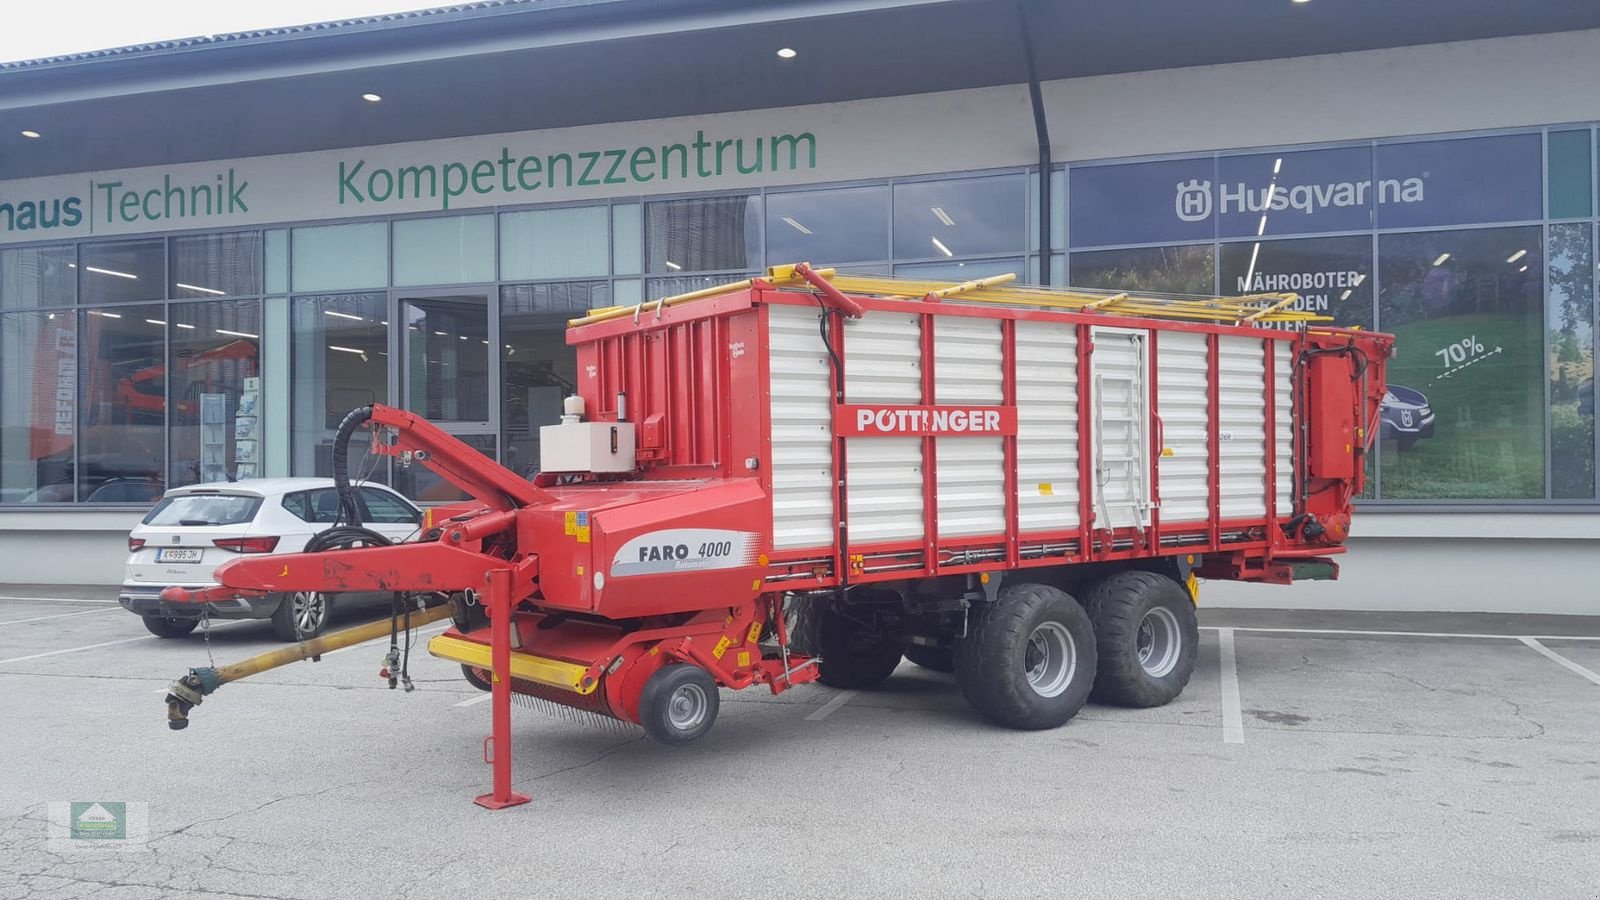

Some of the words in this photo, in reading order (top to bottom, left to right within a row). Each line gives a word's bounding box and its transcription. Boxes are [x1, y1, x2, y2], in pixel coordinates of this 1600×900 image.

[339, 130, 816, 209] Kompetenzzentrum
[96, 168, 249, 223] Technik
[1220, 177, 1424, 214] Husqvarna
[1237, 271, 1359, 292] MÄHROBOTER
[1435, 335, 1484, 368] 70%
[639, 544, 689, 562] FARO
[698, 541, 731, 558] 4000
